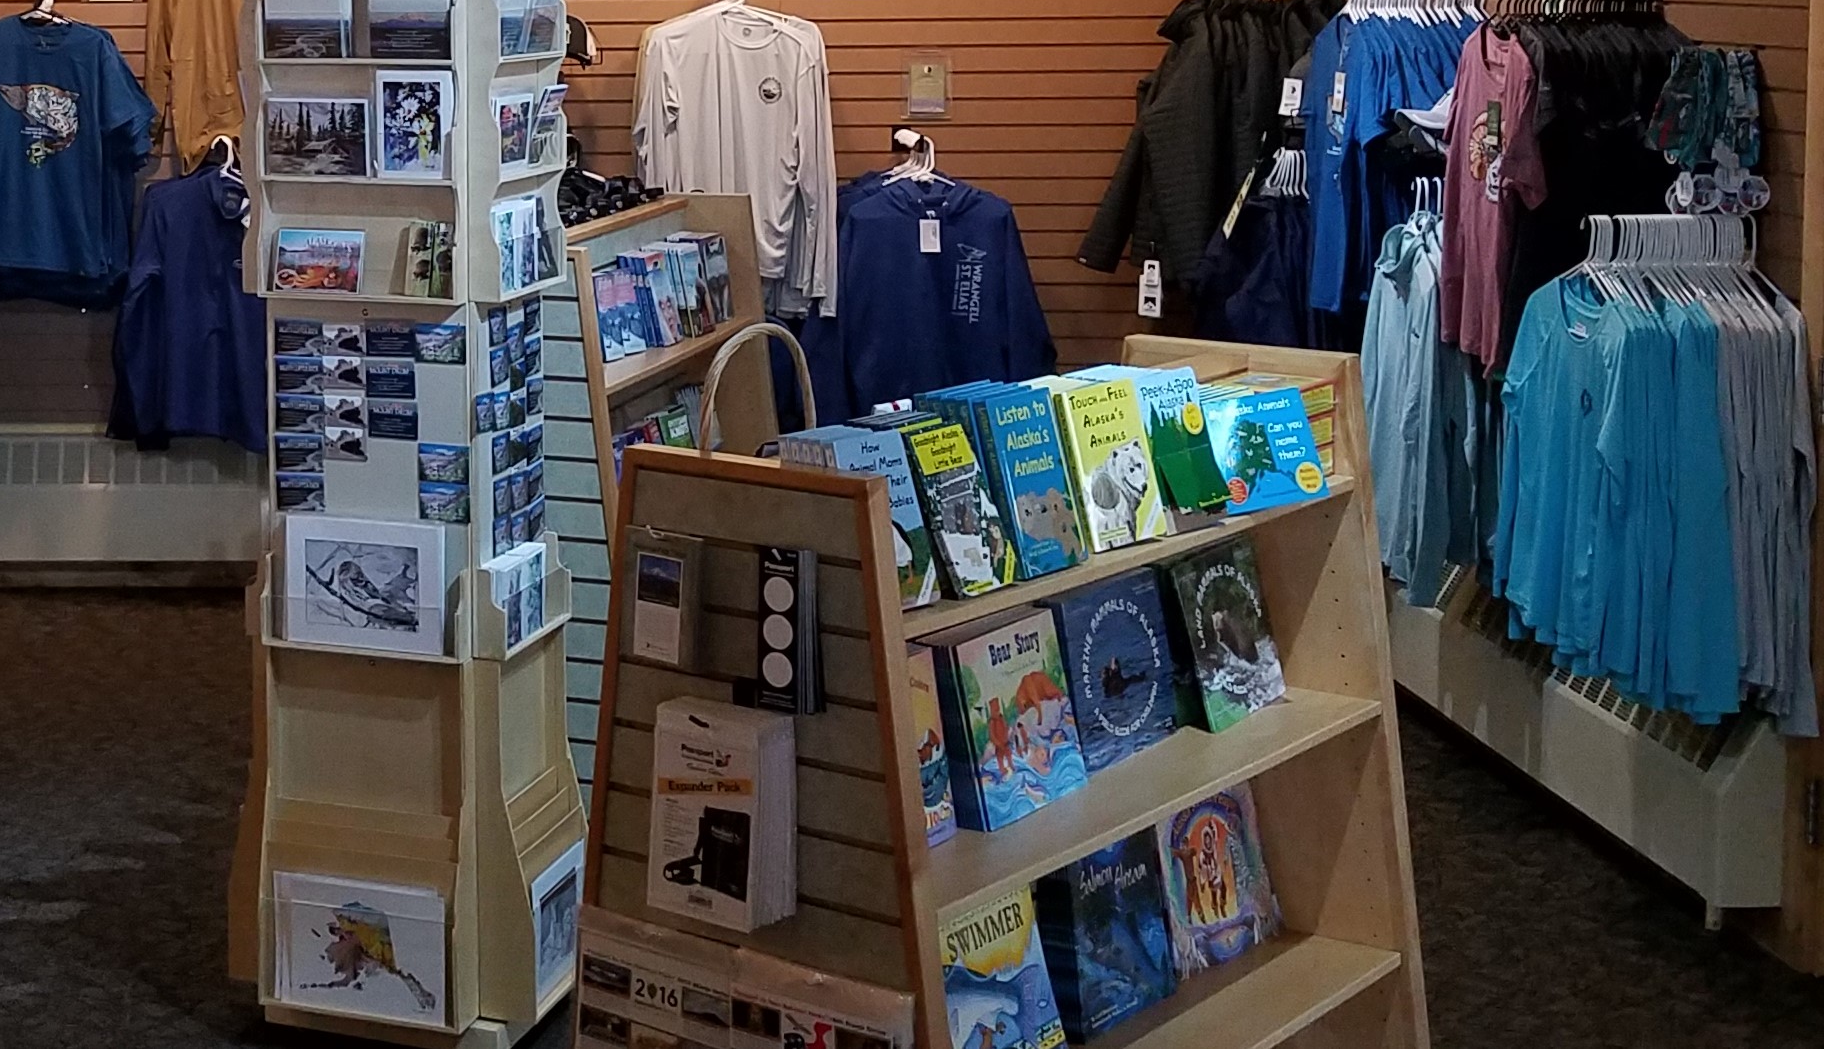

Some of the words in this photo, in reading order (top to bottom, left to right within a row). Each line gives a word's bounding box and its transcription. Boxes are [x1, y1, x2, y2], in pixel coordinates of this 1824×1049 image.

[961, 264, 972, 279] ST.
[958, 281, 971, 311] ELIAS
[969, 264, 983, 324] WRANGELL
[996, 406, 1031, 427] Listen
[1033, 401, 1046, 417] to
[1267, 422, 1285, 433] Can
[1287, 420, 1304, 433] you
[861, 442, 880, 455] How
[1006, 425, 1051, 452] Alaska's
[1275, 436, 1299, 447] name
[878, 456, 904, 471] Moms
[1014, 451, 1055, 478] Animals
[1278, 447, 1307, 461] them?
[764, 561, 795, 574] Passport
[1195, 608, 1207, 649] LAND
[1224, 564, 1236, 578] OF
[988, 642, 1012, 667] Bear
[1014, 631, 1041, 655] Story
[1082, 633, 1093, 699] MARINE
[1126, 601, 1139, 615] OF
[668, 780, 714, 793] Expander
[717, 781, 741, 793] Pack
[1079, 865, 1114, 900] Salmon
[1114, 863, 1148, 892] Stream
[945, 901, 1024, 962] SWIMMER
